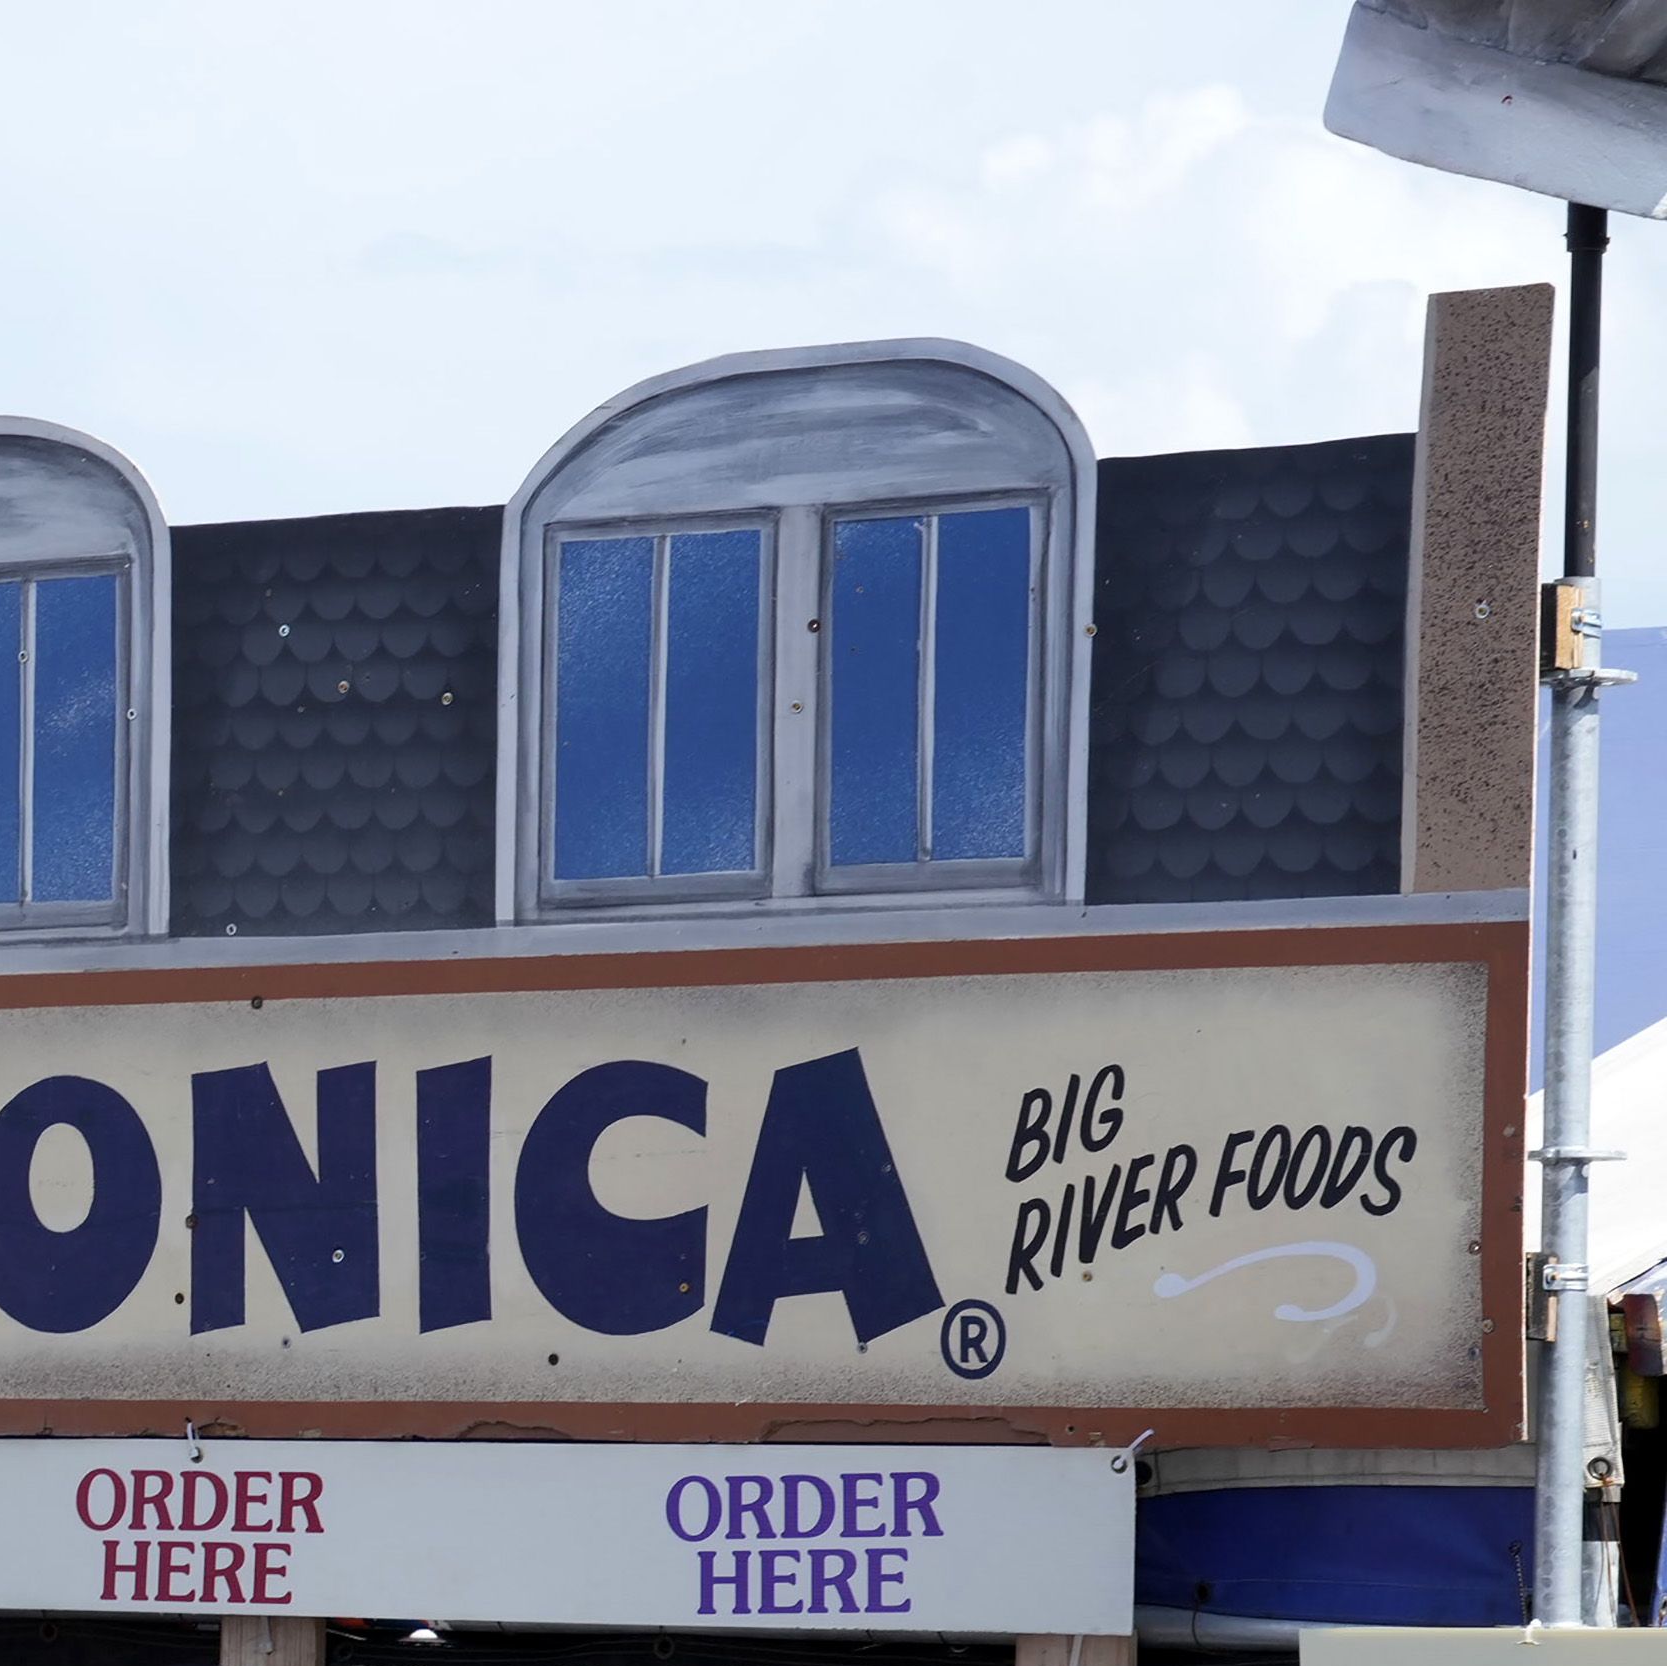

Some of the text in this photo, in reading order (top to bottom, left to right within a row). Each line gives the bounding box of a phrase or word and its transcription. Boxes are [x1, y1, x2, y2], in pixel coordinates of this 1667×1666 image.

[1005, 1064, 1124, 1183] BIG
[1005, 1125, 1417, 1295] RIVER FOODS
[76, 1468, 324, 1533] ORDER
[666, 1472, 944, 1542] ORDER
[100, 1540, 292, 1604] HERE
[697, 1548, 911, 1614] HERE
